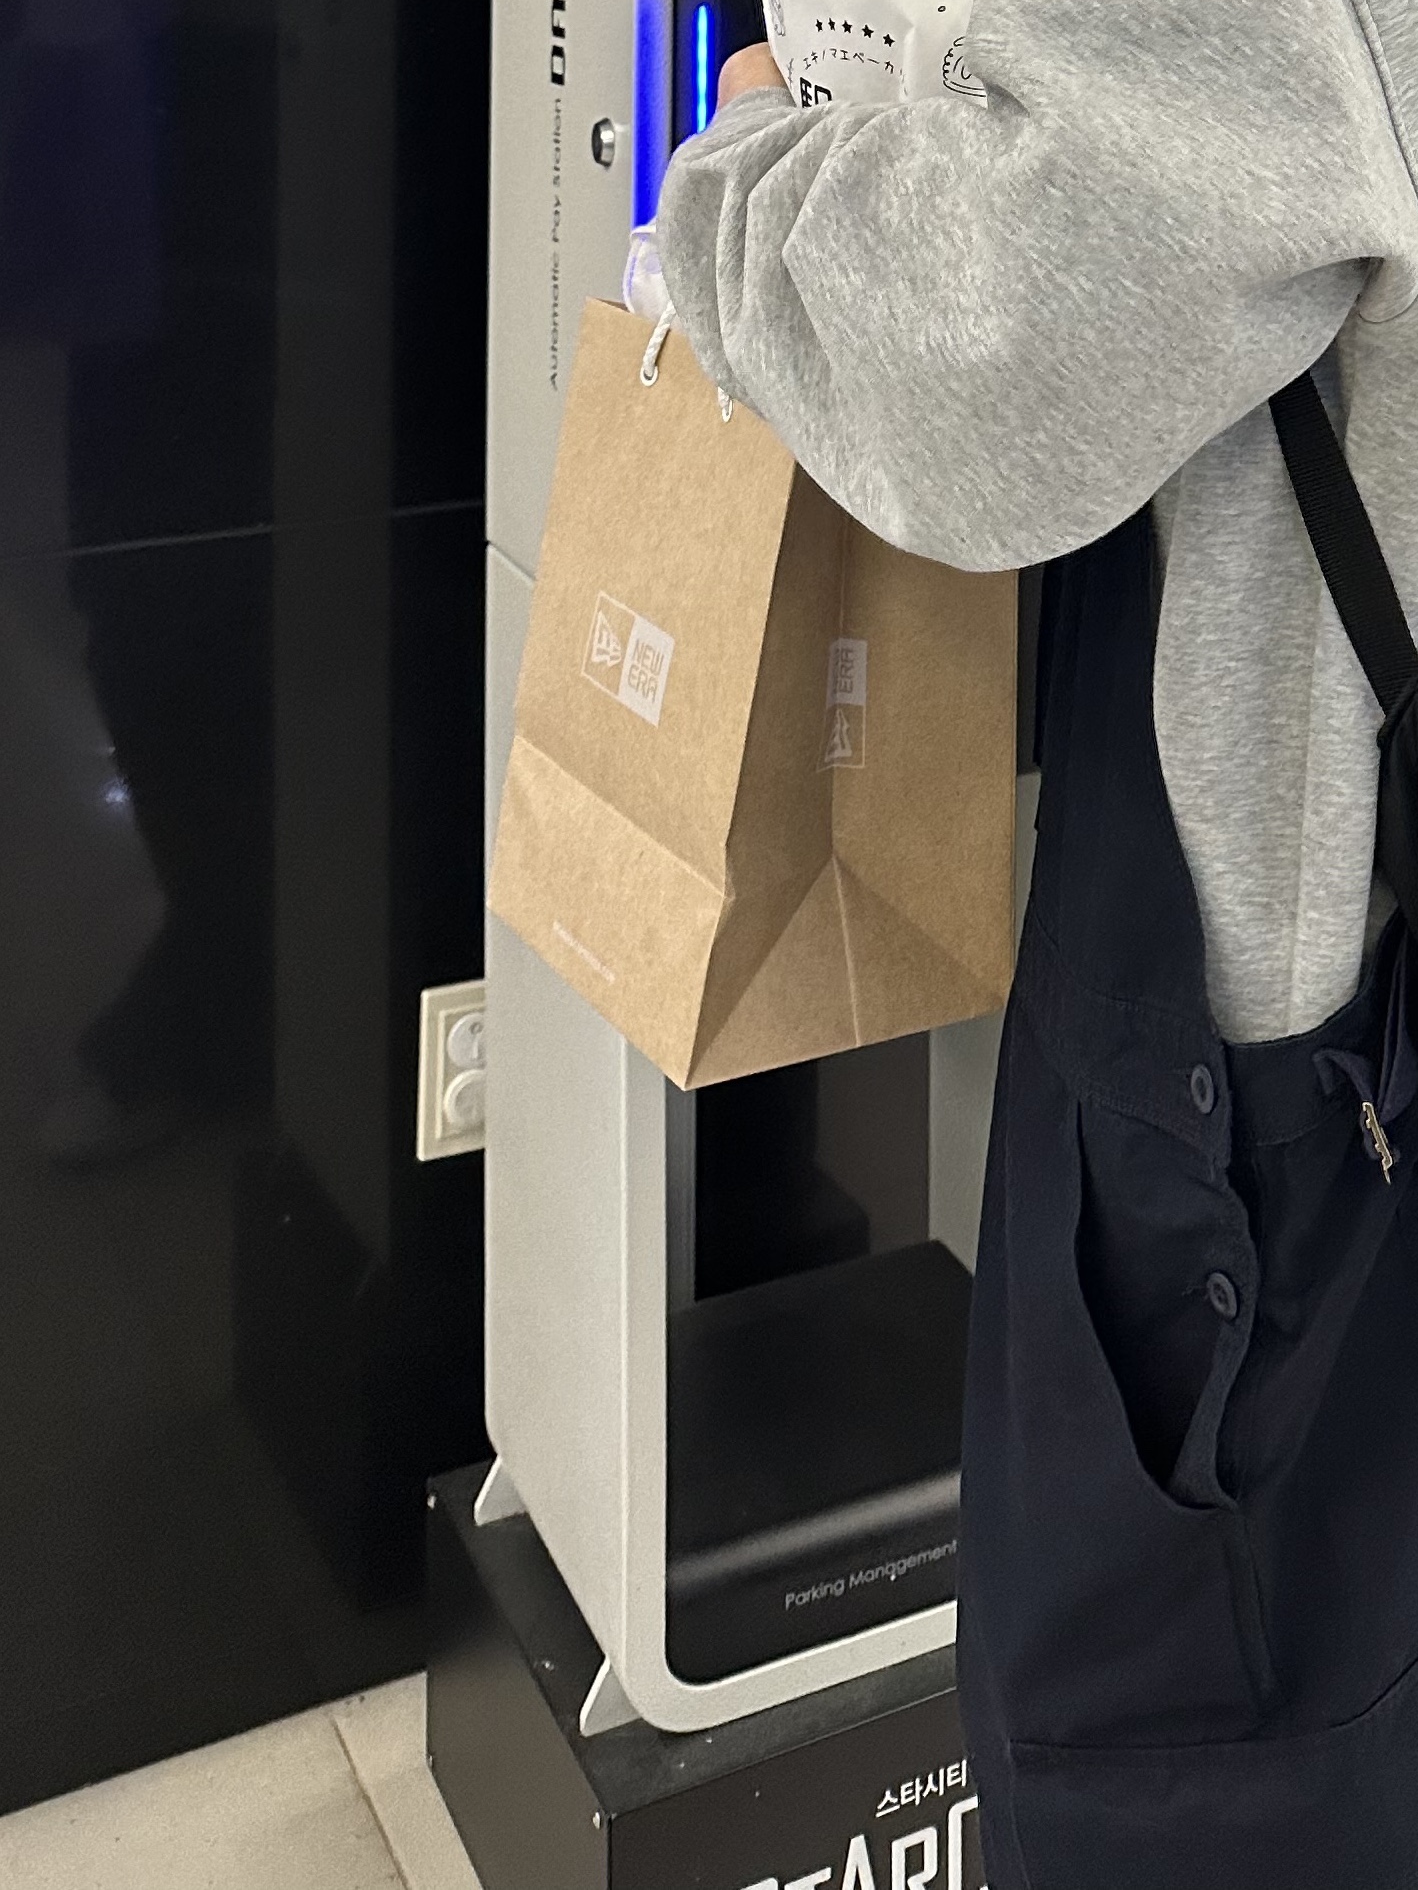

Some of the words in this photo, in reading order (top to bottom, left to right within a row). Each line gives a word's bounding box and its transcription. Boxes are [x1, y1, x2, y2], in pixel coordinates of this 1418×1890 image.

[552, 97, 562, 187] Station
[551, 194, 561, 242] Pay
[550, 251, 560, 392] Automatic
[628, 664, 658, 703] ERA
[633, 638, 665, 676] NEW
[785, 1577, 846, 1610] Parking
[849, 1539, 958, 1589] Management
[875, 1759, 967, 1818] 스타시티
